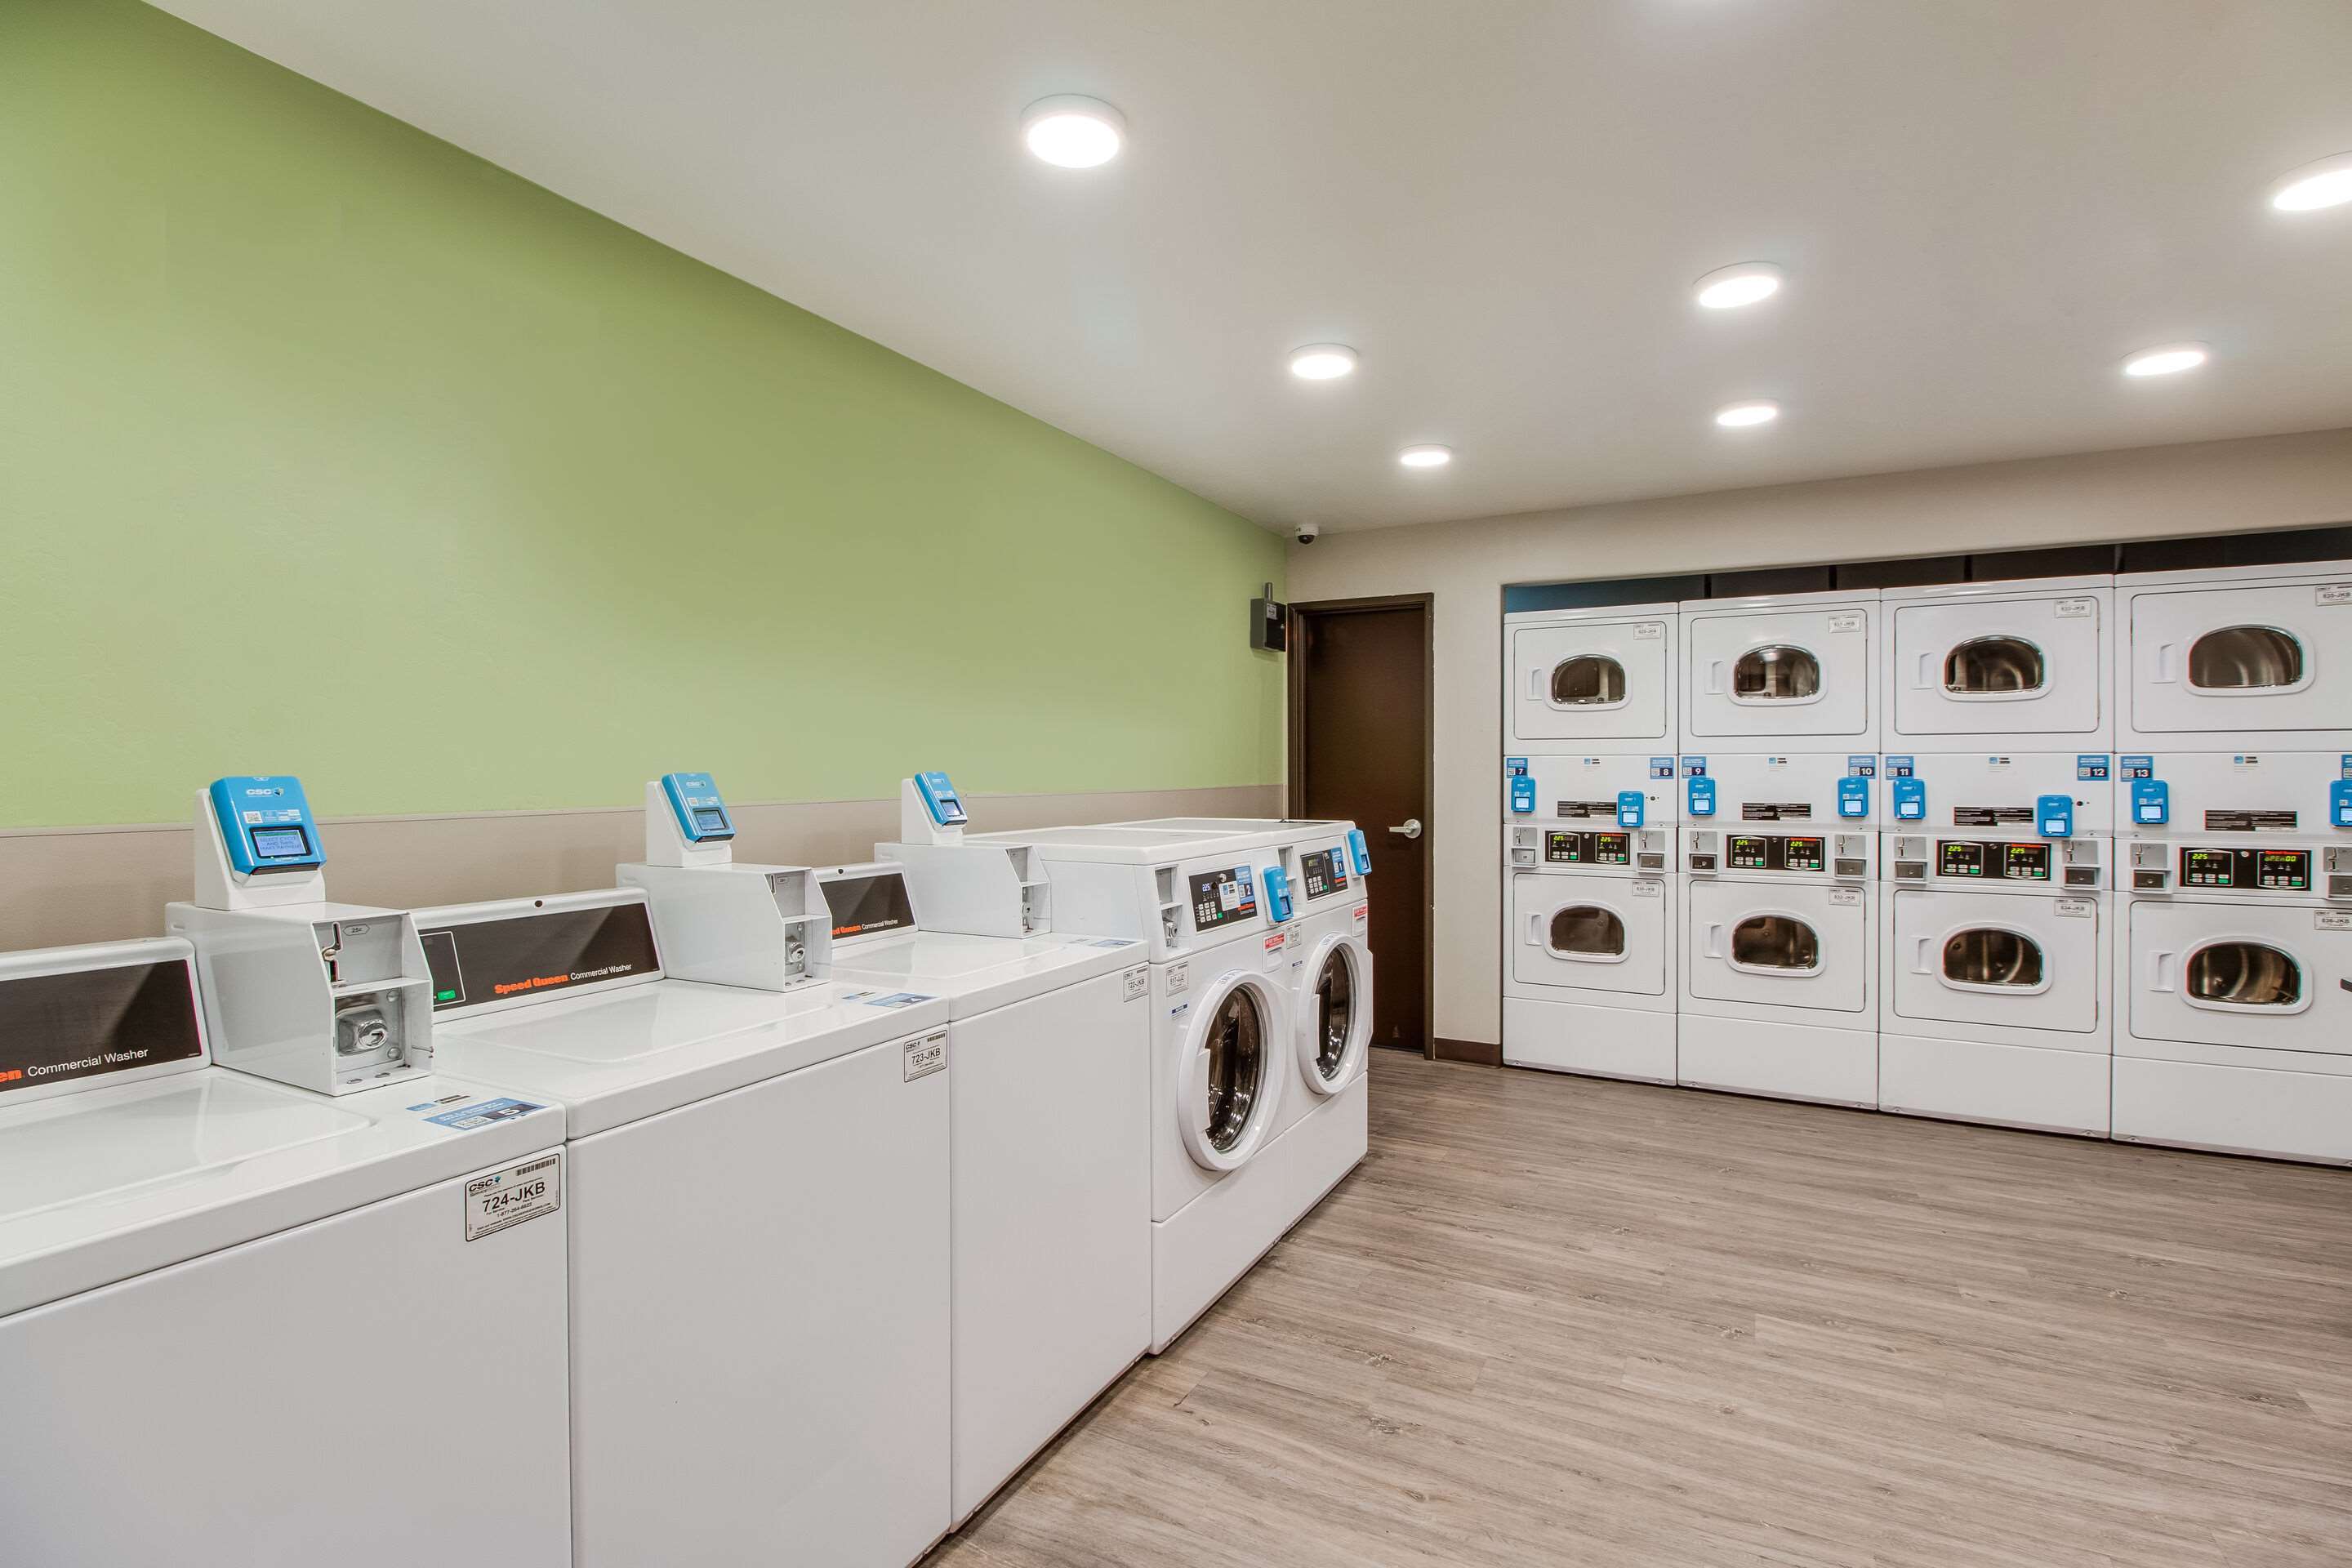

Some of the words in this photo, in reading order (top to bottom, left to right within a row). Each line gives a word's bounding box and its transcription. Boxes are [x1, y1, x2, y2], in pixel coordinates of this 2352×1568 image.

[2136, 769, 2149, 777] 13
[1246, 884, 1251, 895] 2
[494, 979, 532, 994] Speed
[532, 974, 568, 987] Queen
[570, 967, 608, 981] Commercial
[609, 963, 632, 973] Washer
[27, 1055, 102, 1077] Commercial
[104, 1049, 149, 1063] Washer
[911, 1048, 941, 1064] 723-JKB
[469, 1178, 493, 1192] CSC
[483, 1182, 546, 1212] 724-JKB
